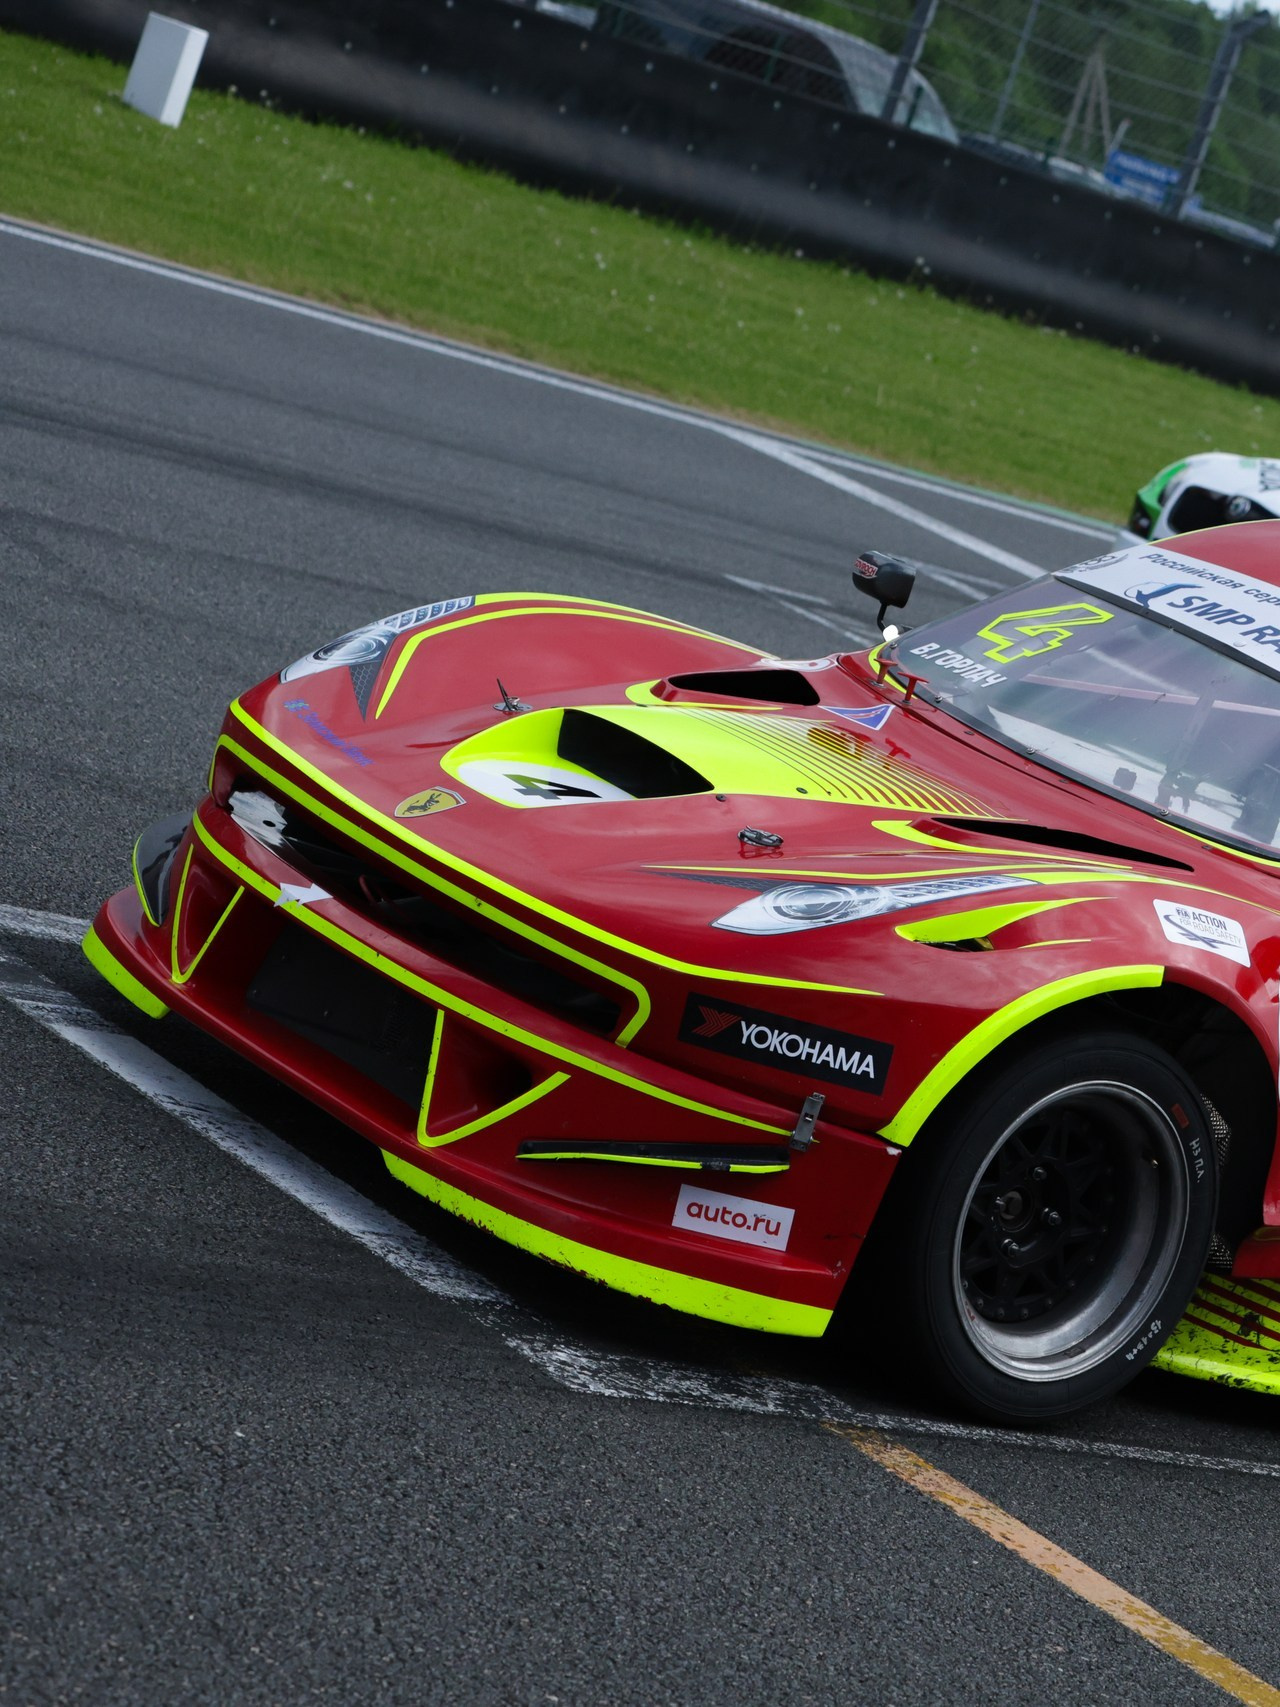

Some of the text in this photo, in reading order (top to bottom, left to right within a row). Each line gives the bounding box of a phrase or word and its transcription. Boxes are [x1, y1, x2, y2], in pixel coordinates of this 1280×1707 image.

[1139, 553, 1245, 590] Российская
[1166, 595, 1256, 626] SMP
[976, 603, 1115, 664] 4
[910, 642, 1007, 688] В.ГОРЛАЧ
[502, 773, 603, 800] 4
[1192, 911, 1227, 931] ACTION
[1193, 921, 1215, 935] ROAD
[1215, 928, 1243, 944] SAFETY
[739, 1020, 875, 1079] YOKOHAMA
[686, 1198, 781, 1237] auto.ru
